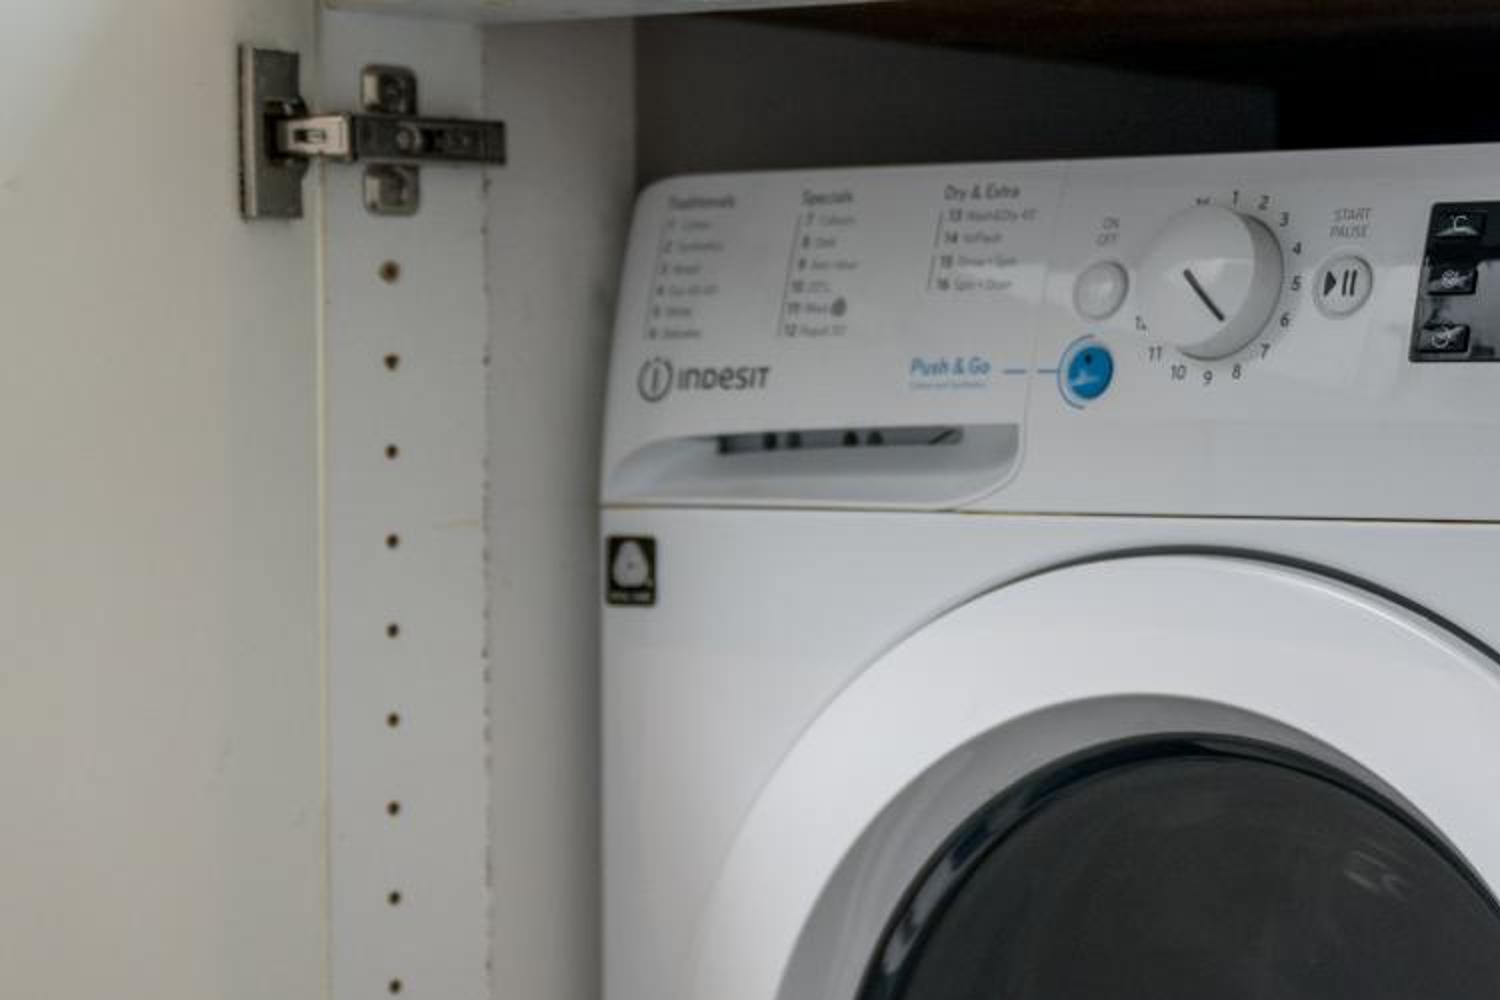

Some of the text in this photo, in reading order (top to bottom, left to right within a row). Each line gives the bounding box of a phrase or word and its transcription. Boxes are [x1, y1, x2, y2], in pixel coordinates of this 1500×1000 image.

[1232, 190, 1239, 206] 1
[1258, 195, 1271, 210] 2
[1280, 212, 1289, 227] 3
[1333, 208, 1372, 221] START
[1330, 225, 1368, 238] PAUSE
[1291, 242, 1302, 255] 4
[1291, 276, 1302, 291] 5
[1280, 312, 1289, 327] 6
[1149, 346, 1162, 361] 11
[1260, 343, 1271, 360] 7
[910, 356, 992, 377] Push & Go
[1171, 364, 1187, 380] 10
[1232, 363, 1241, 379] 8
[1203, 370, 1213, 386] 9
